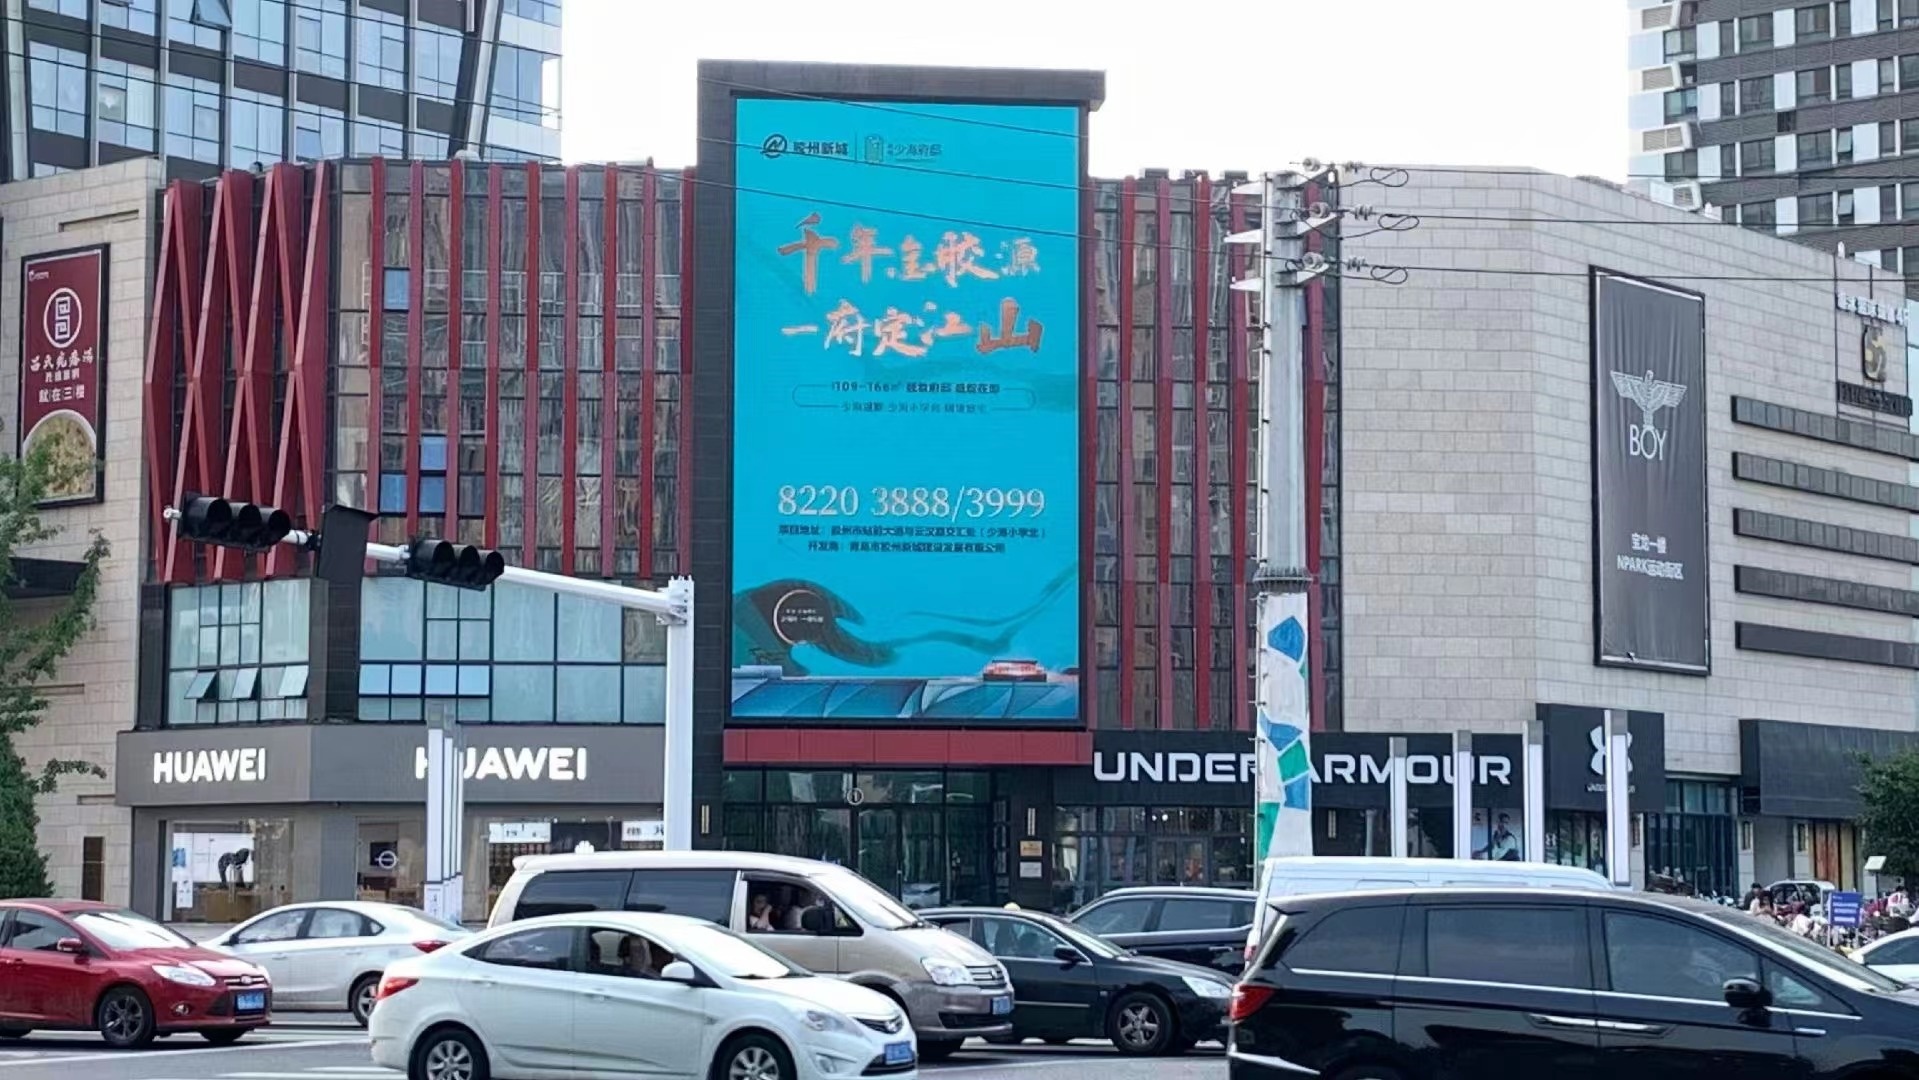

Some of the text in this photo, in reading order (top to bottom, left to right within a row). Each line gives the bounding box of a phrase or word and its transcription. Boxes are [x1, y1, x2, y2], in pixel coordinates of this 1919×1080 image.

[781, 297, 1044, 356] 一府定江山
[1629, 424, 1668, 461] BOY
[778, 485, 1046, 523] 8220 3888/3999
[154, 747, 266, 784] HUAWEI
[1310, 754, 1512, 784] RMOR
